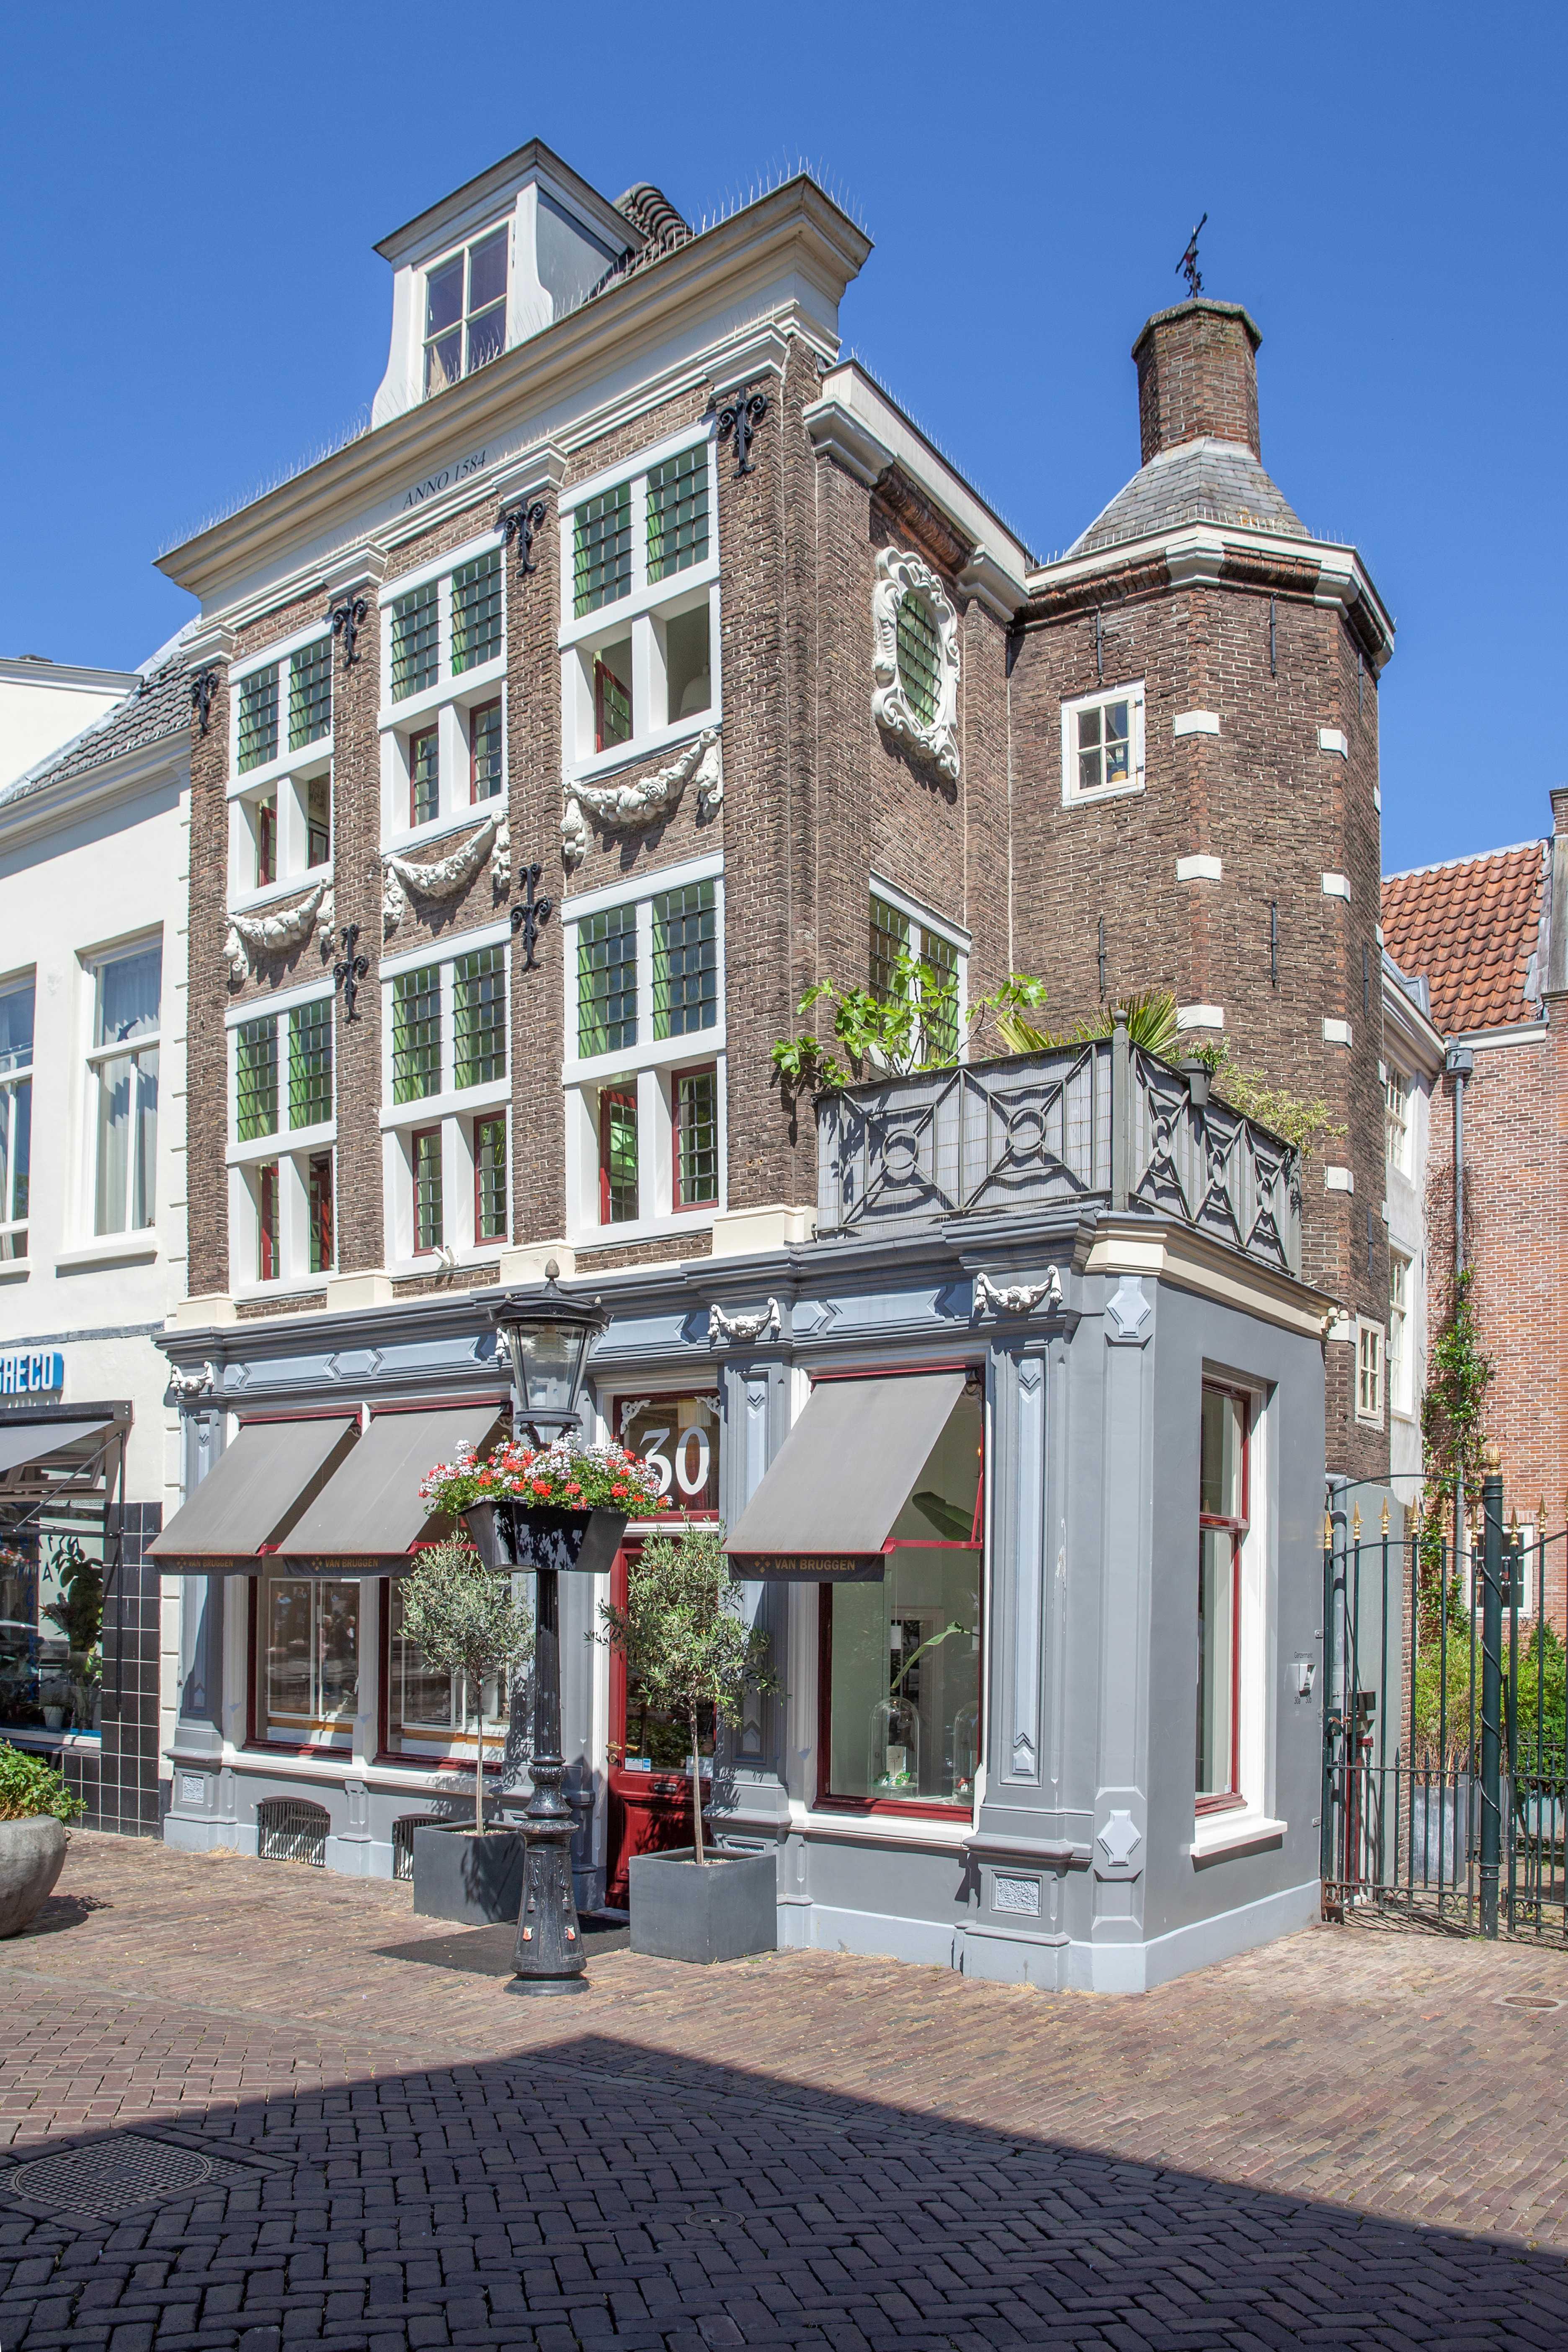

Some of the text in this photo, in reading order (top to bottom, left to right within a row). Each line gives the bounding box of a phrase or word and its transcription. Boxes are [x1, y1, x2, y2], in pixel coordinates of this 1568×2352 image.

[403, 450, 486, 510] ANNO 1584
[639, 1426, 709, 1496] 30
[203, 1559, 234, 1568] BRUGGEN
[325, 1558, 379, 1568] VAN BRUGGEN
[775, 1559, 856, 1571] VAN BRUGGEN
